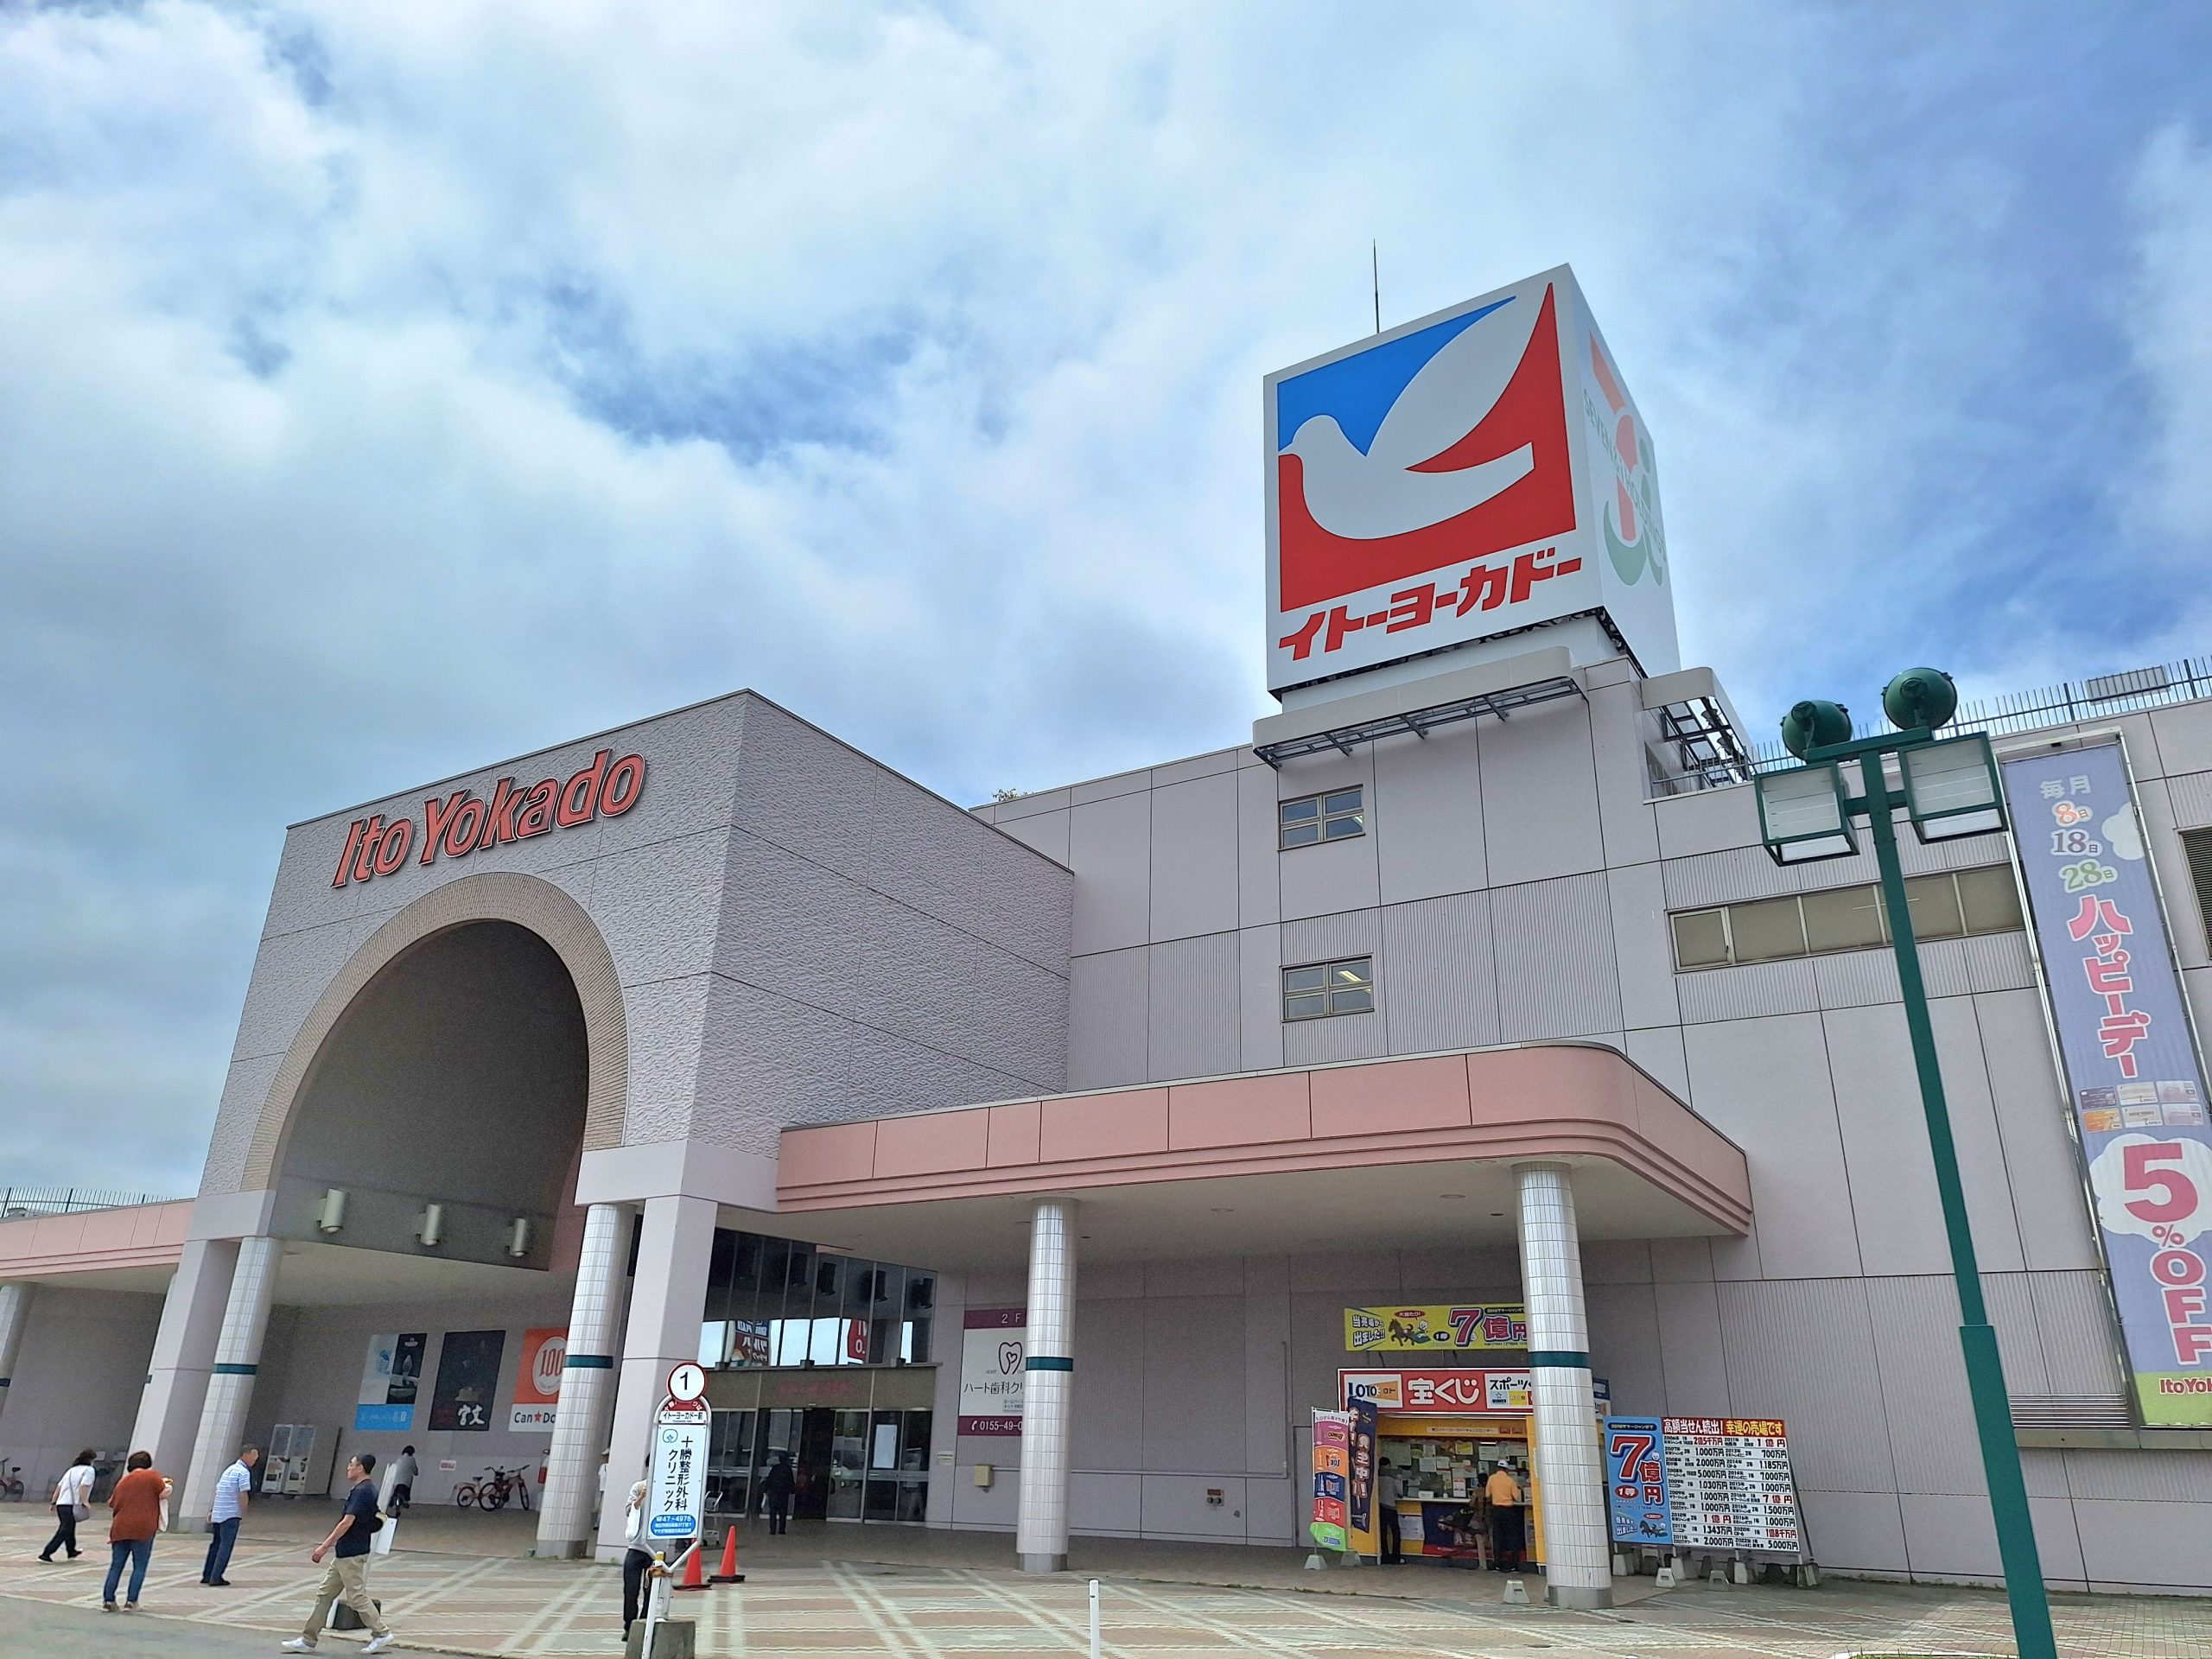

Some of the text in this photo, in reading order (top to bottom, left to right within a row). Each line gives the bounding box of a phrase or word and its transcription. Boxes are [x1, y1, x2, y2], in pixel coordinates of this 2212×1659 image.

[1279, 547, 1582, 661] イトーヨーカドー
[2040, 775, 2091, 798] 毎月
[331, 748, 646, 888] Ito Yokado
[2055, 803, 2089, 824] 8日
[2054, 831, 2098, 854] 18日
[2062, 861, 2113, 890] 28日
[2068, 894, 2151, 1078] ハッピーデー
[1449, 1307, 1527, 1346] 7億円
[539, 1348, 565, 1377] 100
[679, 1371, 689, 1390] 1
[1348, 1382, 1377, 1397] LOTO
[1408, 1377, 1480, 1405] 宝くじ
[1726, 1421, 1783, 1435] 幸運の売場です
[1761, 1449, 1786, 1458] 700万円
[664, 1435, 694, 1512] 十勝整形外科 クリニック
[1611, 1434, 1664, 1504] 7億円
